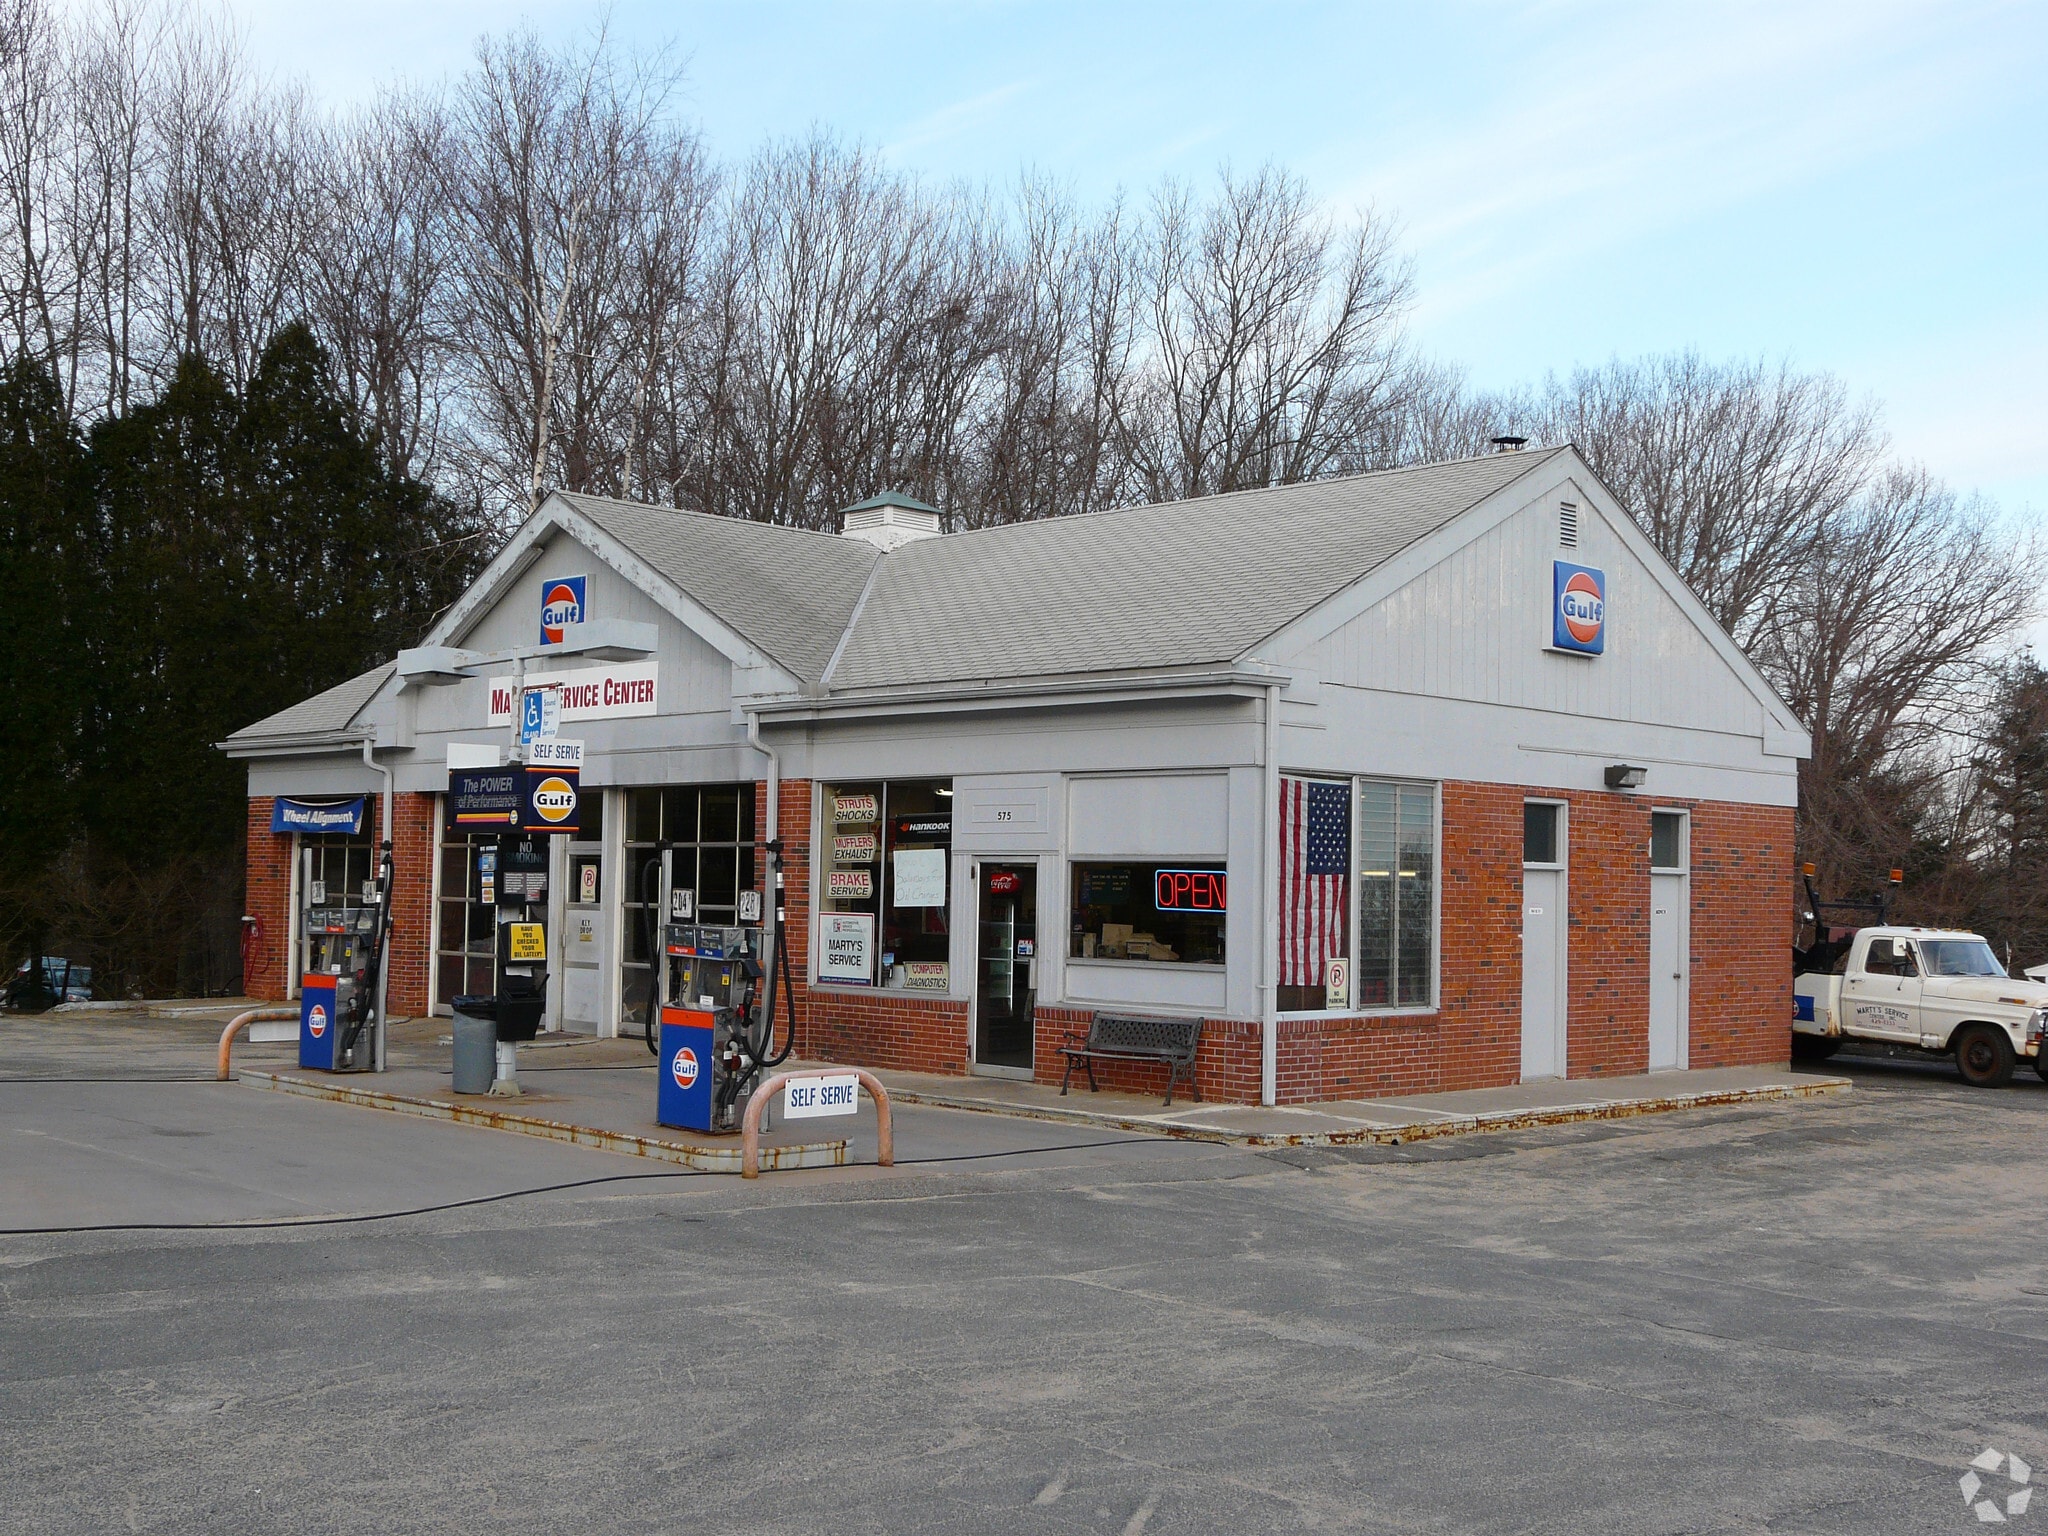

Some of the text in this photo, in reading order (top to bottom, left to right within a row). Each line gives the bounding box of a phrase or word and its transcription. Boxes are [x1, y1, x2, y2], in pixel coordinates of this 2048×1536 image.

[1563, 595, 1602, 621] Gulf
[543, 606, 577, 625] Gulf
[561, 678, 654, 709] RVICE CENTER
[534, 744, 580, 760] SELF SERVE
[464, 777, 513, 792] The POWER
[467, 794, 517, 808] Performance
[537, 794, 572, 805] Gulf
[837, 799, 872, 809] STRUTS
[283, 809, 310, 822] Wheel
[310, 810, 353, 826] Alignment
[835, 810, 874, 820] SHOCKS
[997, 812, 1011, 820] 575
[519, 841, 533, 852] NO
[835, 837, 873, 848] MUFFLERS
[506, 852, 545, 863] SMOKING
[834, 848, 873, 859] EXHAUST
[830, 874, 869, 886] BRAKE
[830, 887, 868, 895] SERVICE
[1158, 874, 1226, 908] OPEN
[829, 939, 862, 951] MARTY'S
[829, 954, 861, 966] SERVICE
[912, 965, 944, 975] COMPUTER
[906, 977, 946, 988] DIAGNOSTICS
[1856, 1006, 1909, 1020] MARTY'S SERVICE
[310, 1016, 325, 1026] Gulf
[674, 1062, 696, 1075] Gulf
[791, 1085, 853, 1107] SELF SERVE
